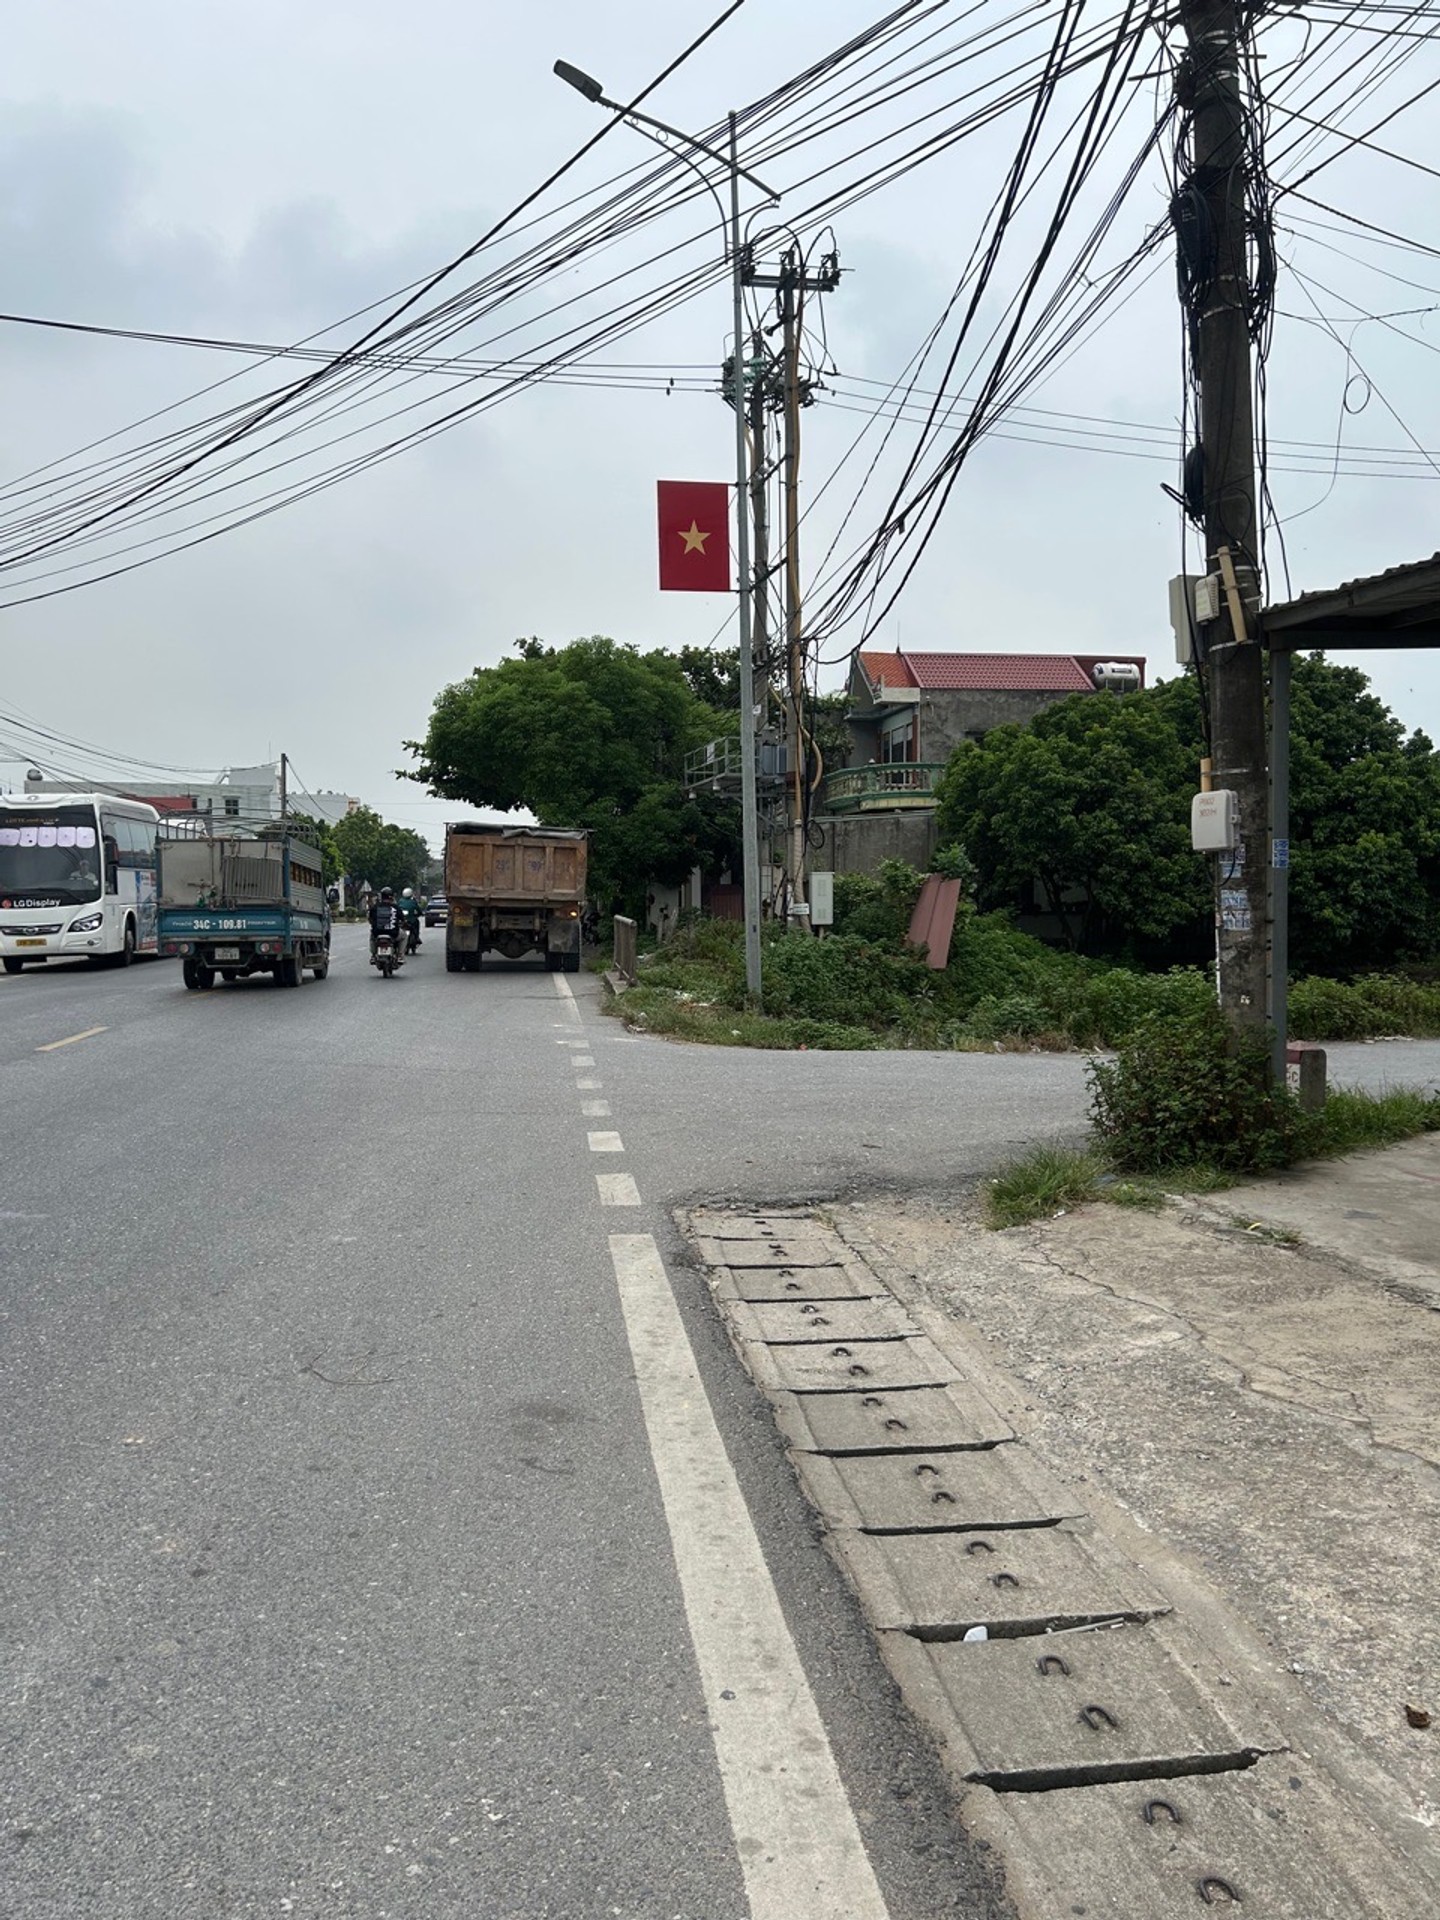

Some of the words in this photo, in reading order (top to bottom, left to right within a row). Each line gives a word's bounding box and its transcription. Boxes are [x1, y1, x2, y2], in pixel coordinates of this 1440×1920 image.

[13, 900, 26, 908] LG
[26, 898, 61, 908] Display
[193, 919, 210, 930] 34C
[218, 919, 247, 930] 109.81
